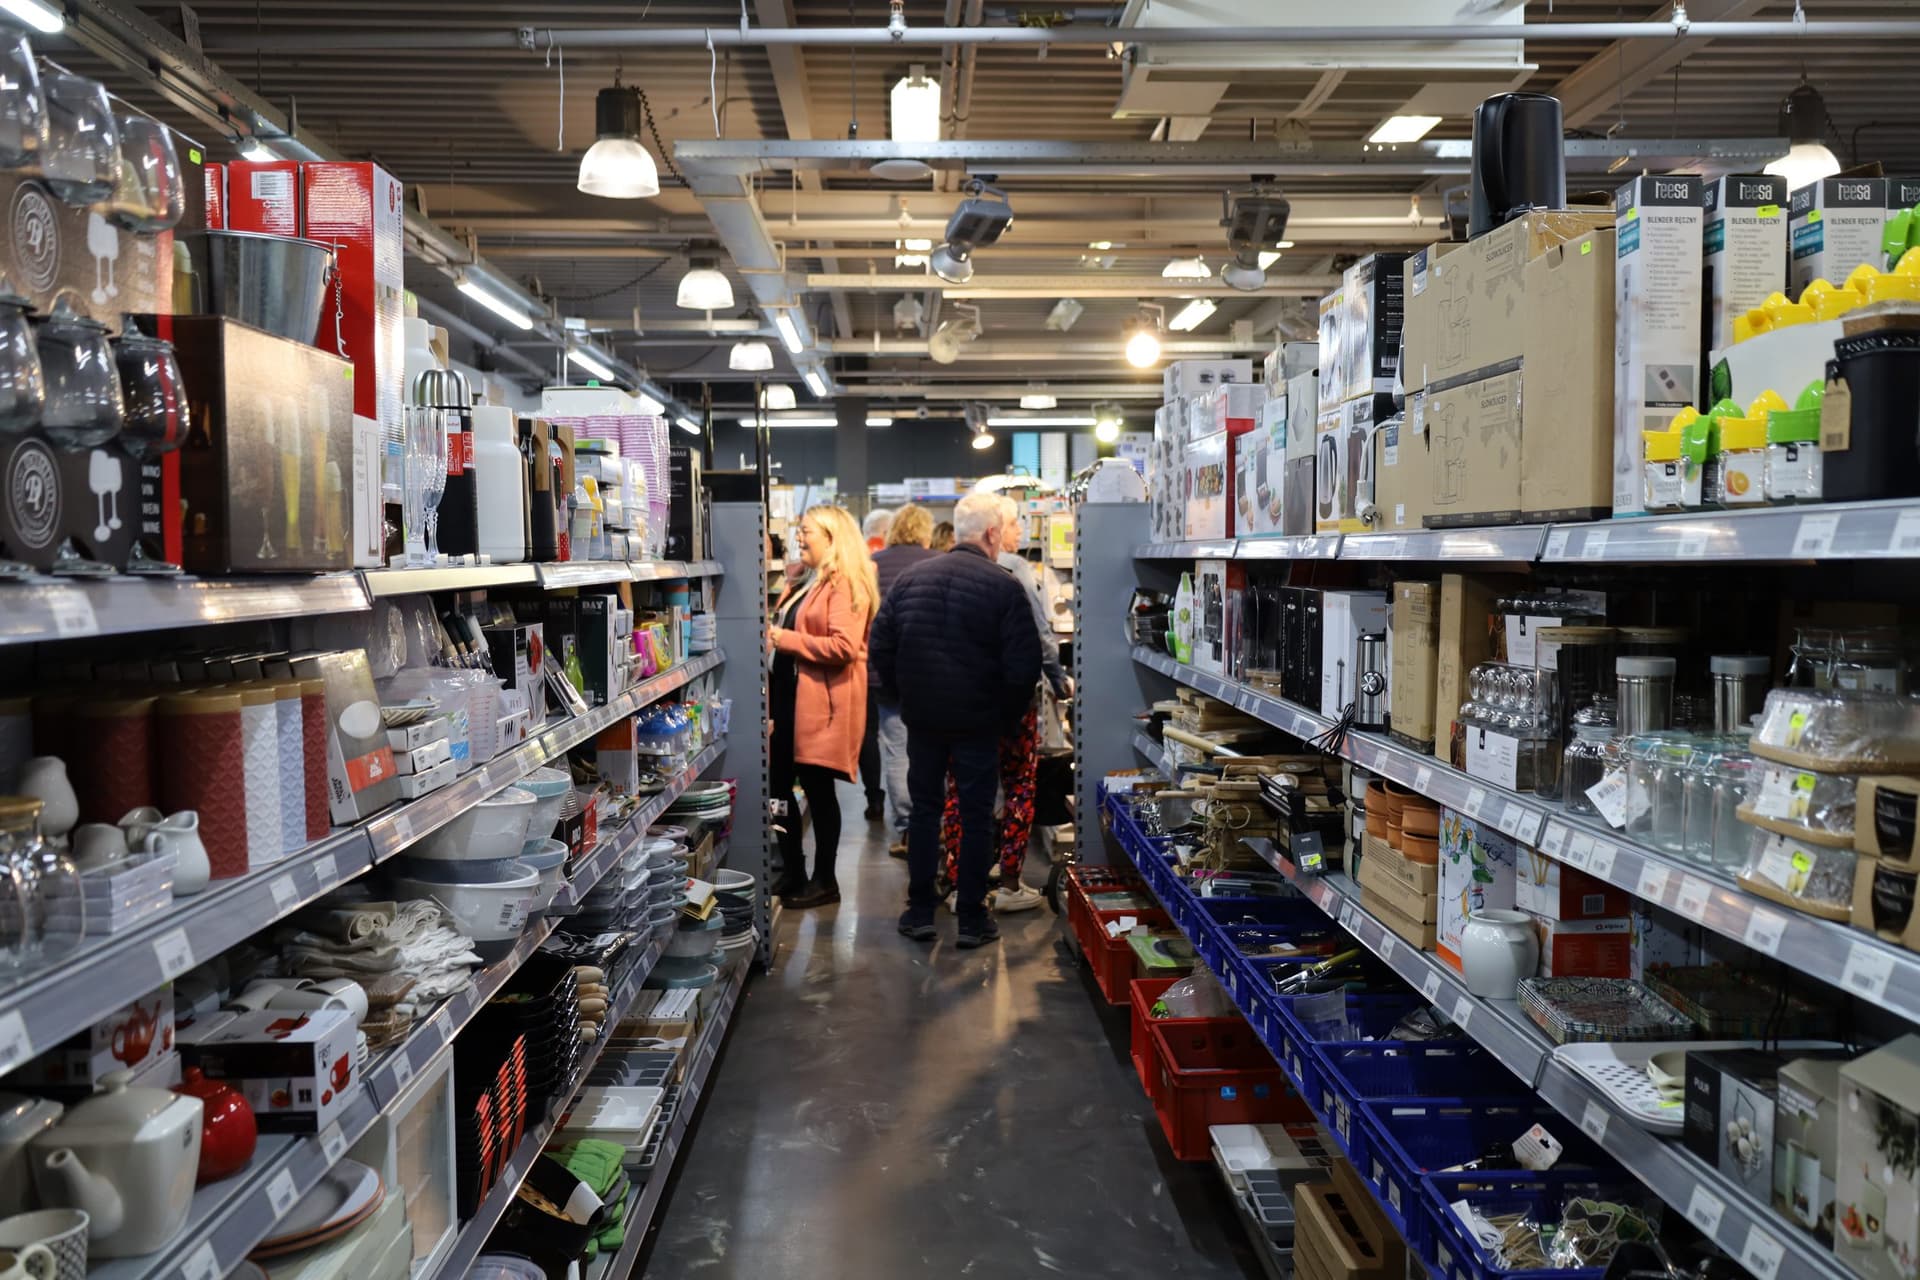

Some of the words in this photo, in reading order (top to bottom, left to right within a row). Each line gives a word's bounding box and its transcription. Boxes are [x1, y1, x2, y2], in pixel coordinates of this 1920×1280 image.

[1655, 181, 1688, 199] reesa
[1740, 182, 1772, 200] reesa
[1838, 183, 1870, 200] reesa
[1901, 184, 1920, 202] ree
[1648, 216, 1673, 224] BLENDER
[1675, 216, 1697, 225] RĘCZNY
[1731, 217, 1757, 225] BLENDER
[1759, 217, 1780, 226] RĘCZNY
[1859, 218, 1879, 226] RĘCZNY
[582, 601, 604, 609] DAY
